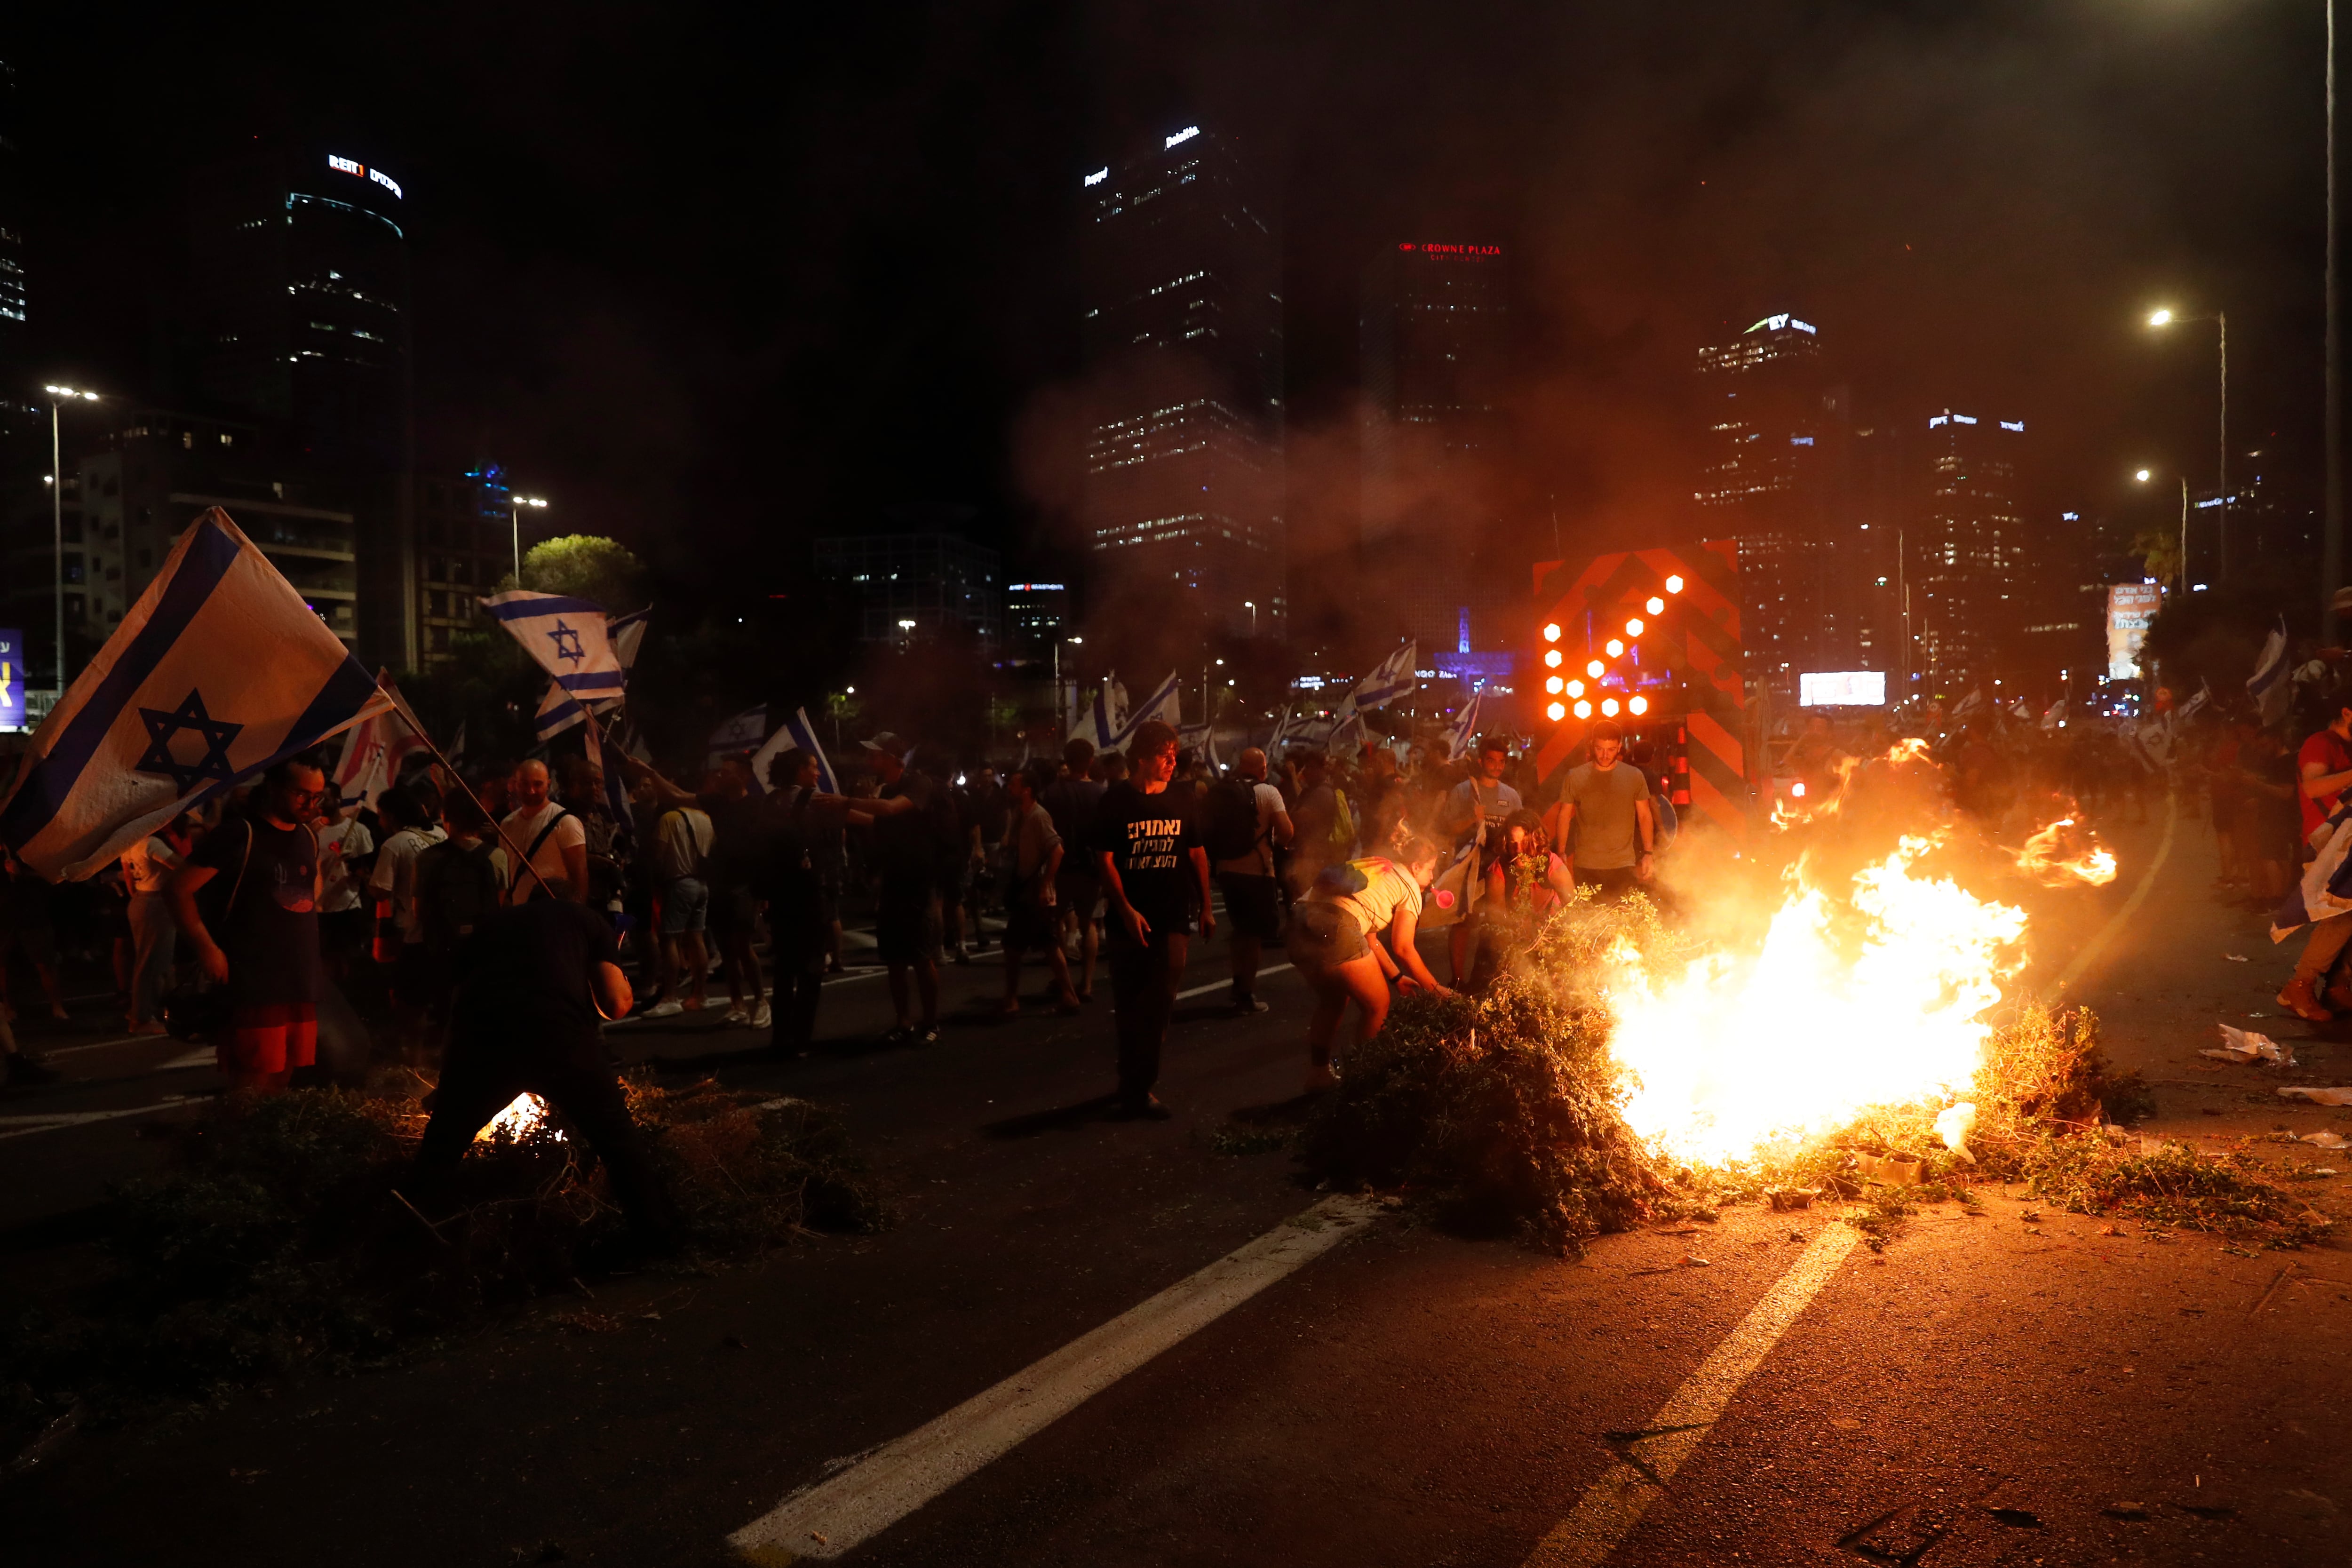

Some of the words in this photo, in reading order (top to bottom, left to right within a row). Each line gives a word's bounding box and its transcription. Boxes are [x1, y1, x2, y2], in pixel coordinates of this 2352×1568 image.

[1085, 166, 1108, 187] Rapyd
[1422, 243, 1465, 253] CROWNE
[1468, 245, 1501, 255] PLAZA
[1768, 313, 1789, 330] EY
[1128, 819, 1181, 839] נאמנים
[1132, 836, 1174, 854] למגילת
